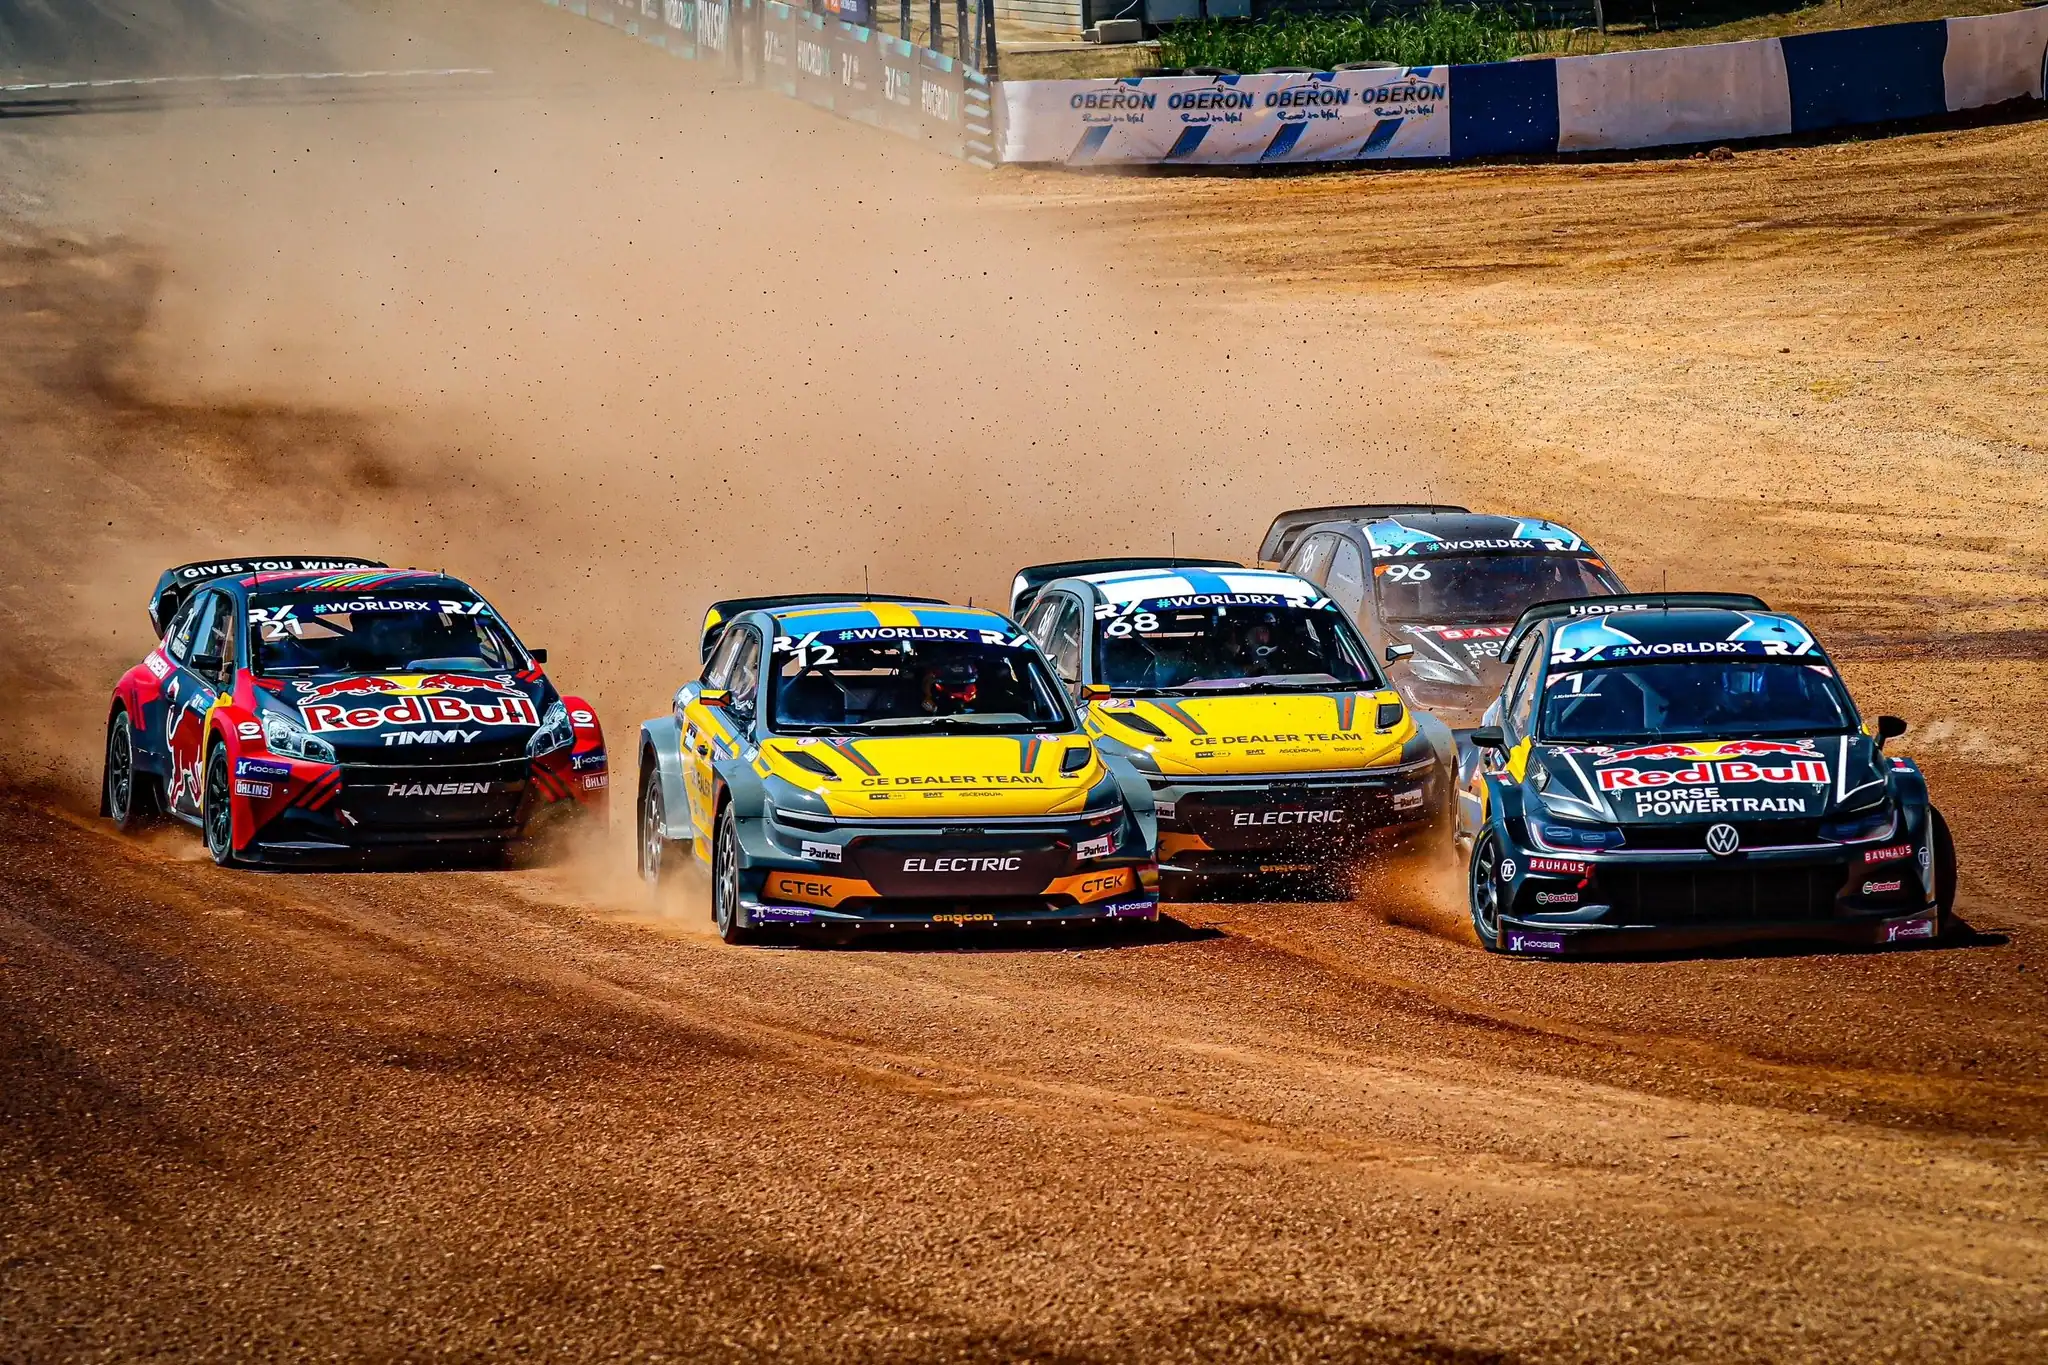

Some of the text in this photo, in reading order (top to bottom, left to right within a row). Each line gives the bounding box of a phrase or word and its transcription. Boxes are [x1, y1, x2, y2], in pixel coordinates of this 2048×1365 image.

[1070, 92, 1157, 110] OBERON
[1167, 92, 1254, 109] OBERON
[1265, 87, 1351, 108] OBERON
[1362, 83, 1447, 104] OBERON
[1427, 539, 1535, 551] #WORLDRX
[184, 563, 243, 579] GIVES
[250, 561, 293, 572] YOU
[1386, 563, 1431, 582] 96
[312, 600, 431, 613] #WORLDRX
[1156, 594, 1279, 608] #WORLDRX
[263, 618, 303, 638] 21
[1107, 613, 1159, 636] 68
[839, 627, 968, 640] #WORLDRX
[790, 645, 838, 667] 12
[1612, 642, 1746, 656] #WORLDRX
[1566, 673, 1583, 693] 1
[300, 696, 539, 733] Red Bull
[380, 730, 482, 746] TIMMY
[1190, 733, 1362, 746] CE DEALER TEAM
[248, 765, 289, 775] HOOSIER
[1598, 761, 1830, 791] Red Bull
[236, 780, 270, 796] ÖHLINS
[861, 775, 1044, 787] CE DEALER TEAM
[388, 782, 490, 797] HANSEN
[1635, 787, 1720, 802] HORSE
[1637, 798, 1806, 817] POWERTRAIN
[1233, 810, 1344, 826] ELECTRIC
[807, 847, 841, 860] Parker
[1865, 845, 1912, 861] BAUHAUS
[902, 857, 1021, 872] ELECTRIC
[1530, 860, 1585, 872] BAUHAUS
[780, 880, 833, 897] CTEK
[1081, 874, 1124, 893] CTEK
[766, 906, 811, 917] HOOSIER
[1118, 901, 1153, 912] HOOSIER
[932, 913, 994, 925] engcon
[1523, 940, 1561, 949] HOOSIER
